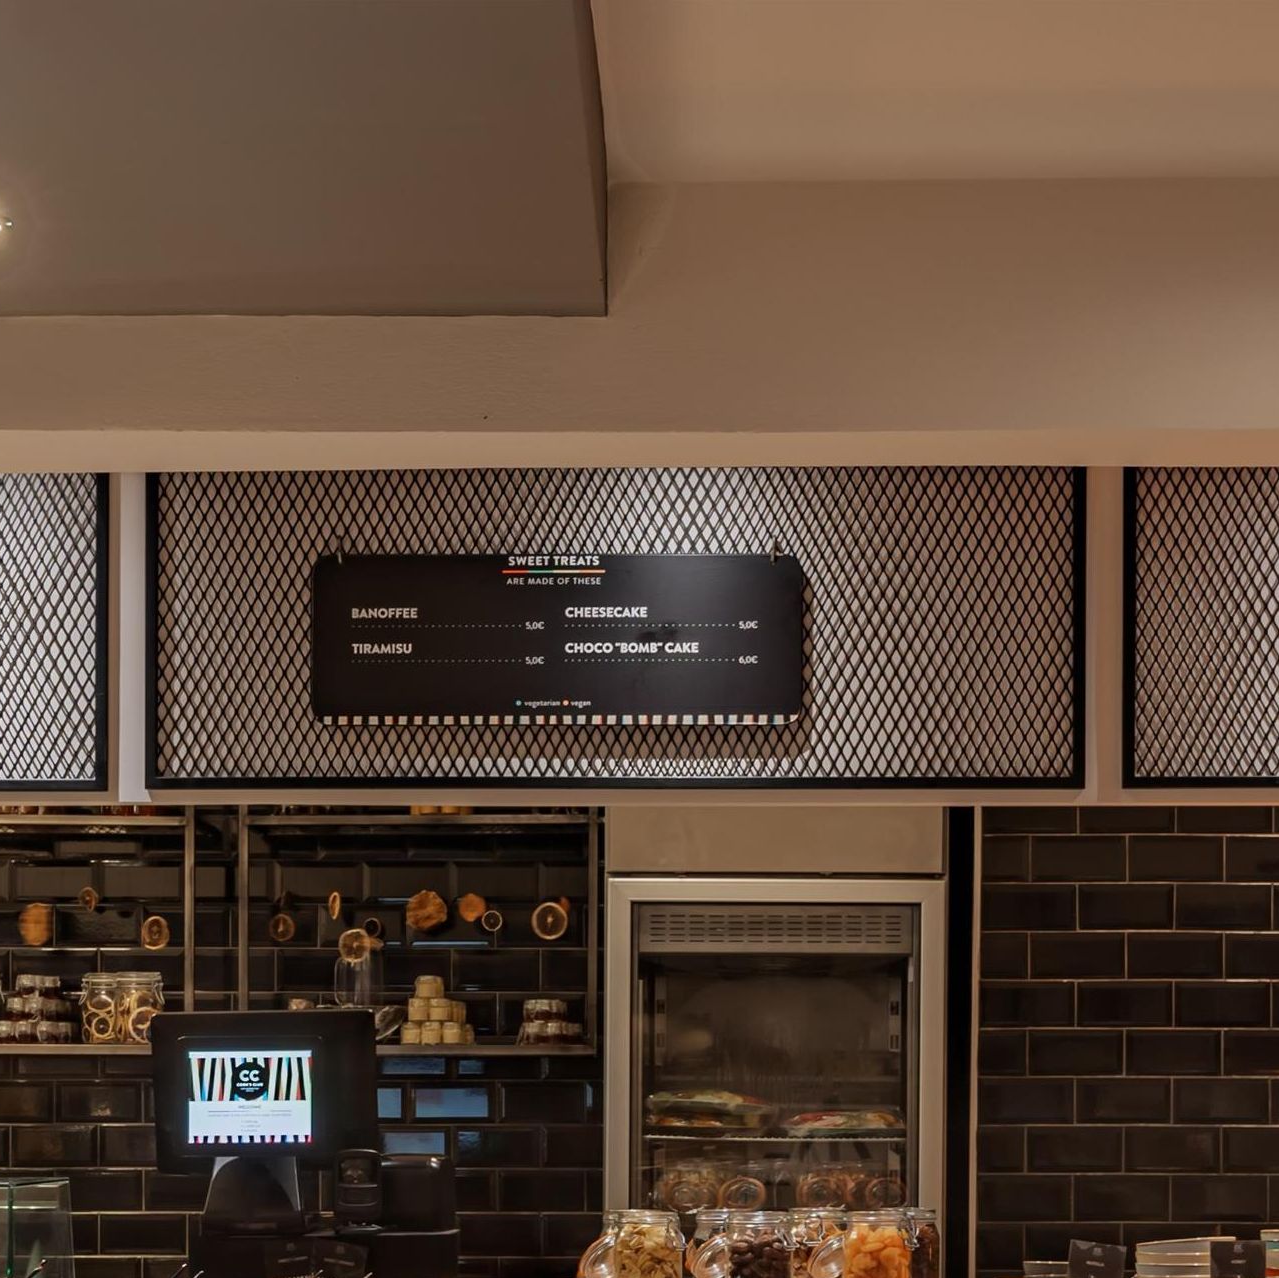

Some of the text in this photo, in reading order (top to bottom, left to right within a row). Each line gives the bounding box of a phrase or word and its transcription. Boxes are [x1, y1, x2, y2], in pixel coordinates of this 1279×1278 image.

[508, 555, 600, 566] SWEET TREATS
[506, 577, 602, 586] ARE MADE OF THESE
[351, 607, 418, 619] BANOFFEE
[564, 606, 648, 618] CHEESECAKE
[525, 621, 545, 630] 5,0€
[738, 620, 759, 630] 5,0€
[351, 643, 413, 655] TIRAMISU
[564, 642, 614, 654] CHOCO
[664, 642, 700, 654] CAKE
[525, 656, 545, 666] 5,0€
[738, 655, 759, 665] 6,0€
[524, 699, 592, 709] vegetarian vegan
[239, 1069, 260, 1082] CC
